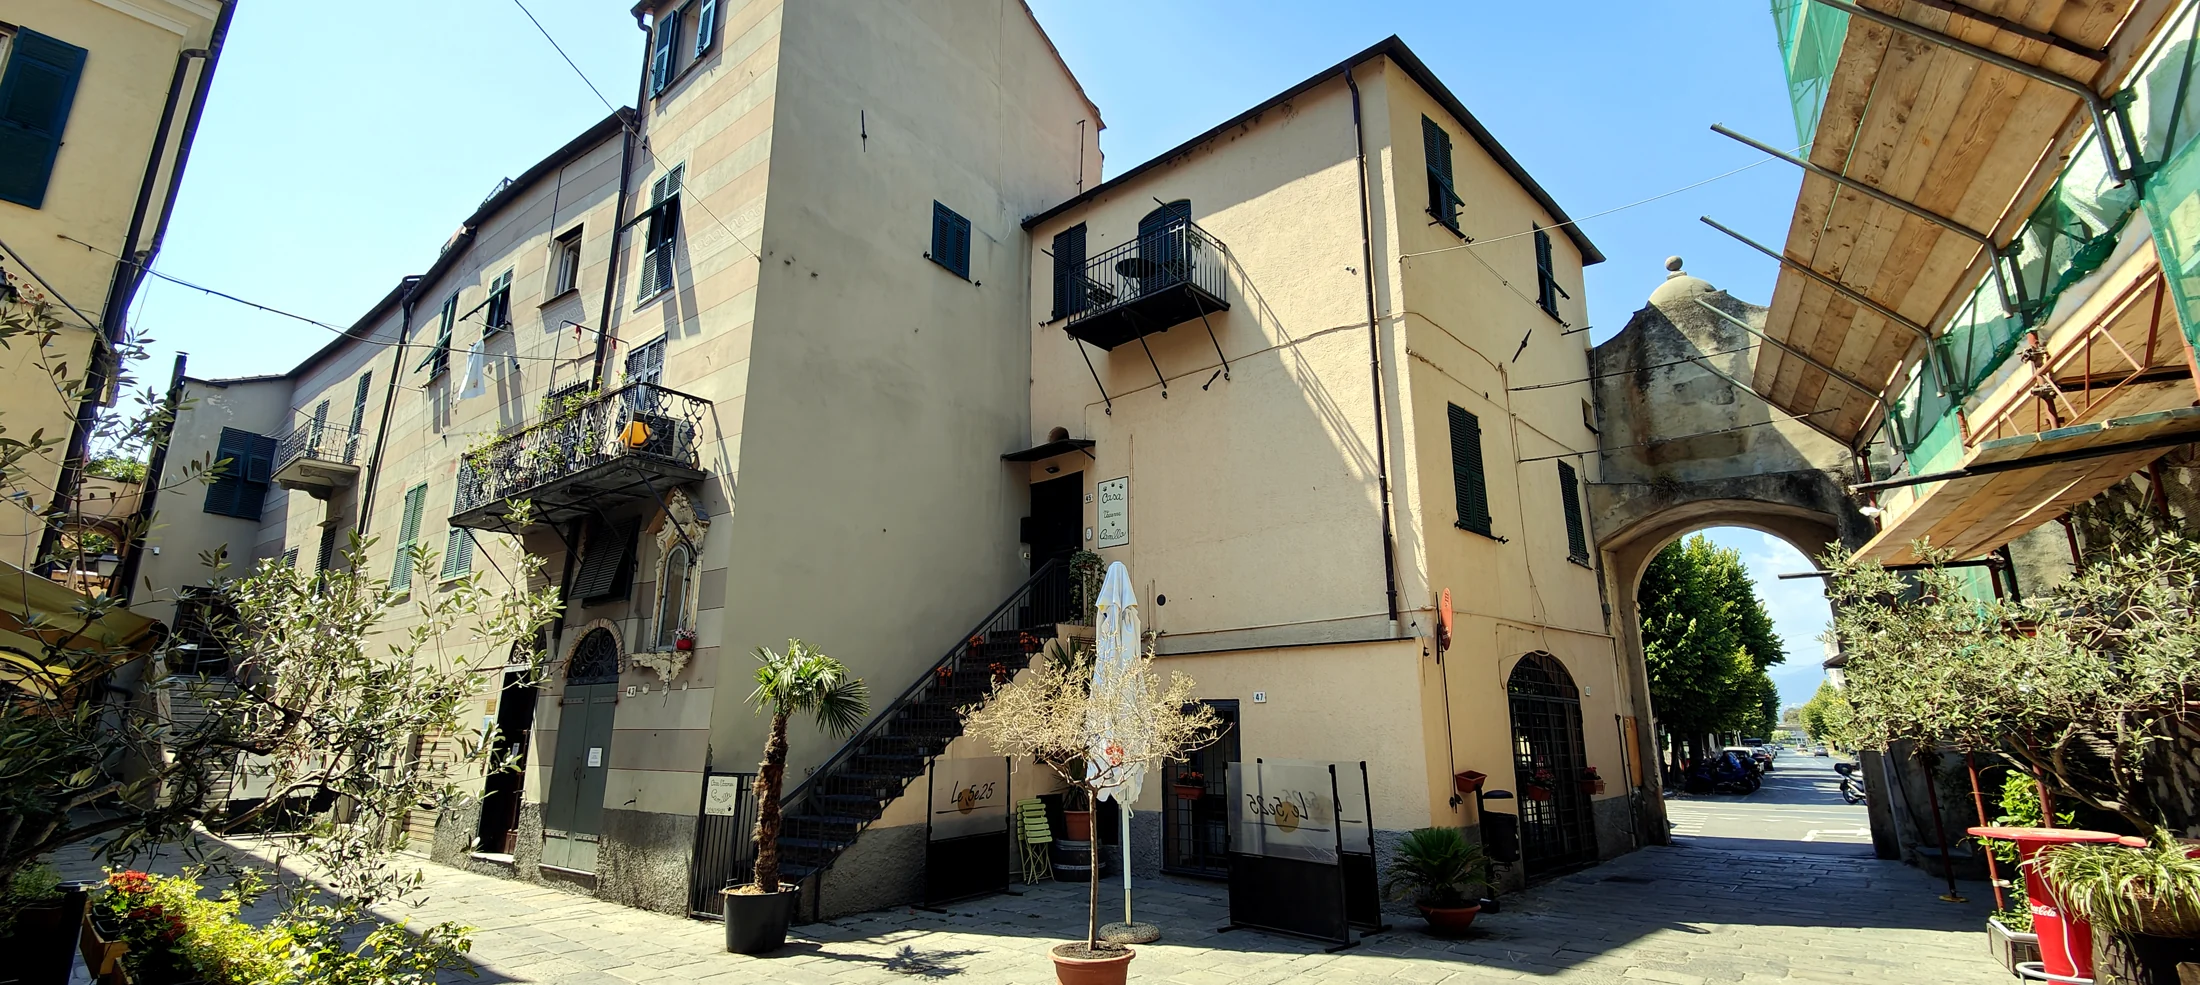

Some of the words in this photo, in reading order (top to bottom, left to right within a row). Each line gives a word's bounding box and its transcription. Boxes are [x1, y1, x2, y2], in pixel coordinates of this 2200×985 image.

[1102, 492, 1123, 503] Casa
[1100, 528, 1126, 540] Camilla
[1255, 693, 1264, 701] 47
[951, 780, 963, 804] Le
[968, 782, 996, 802] 5e25
